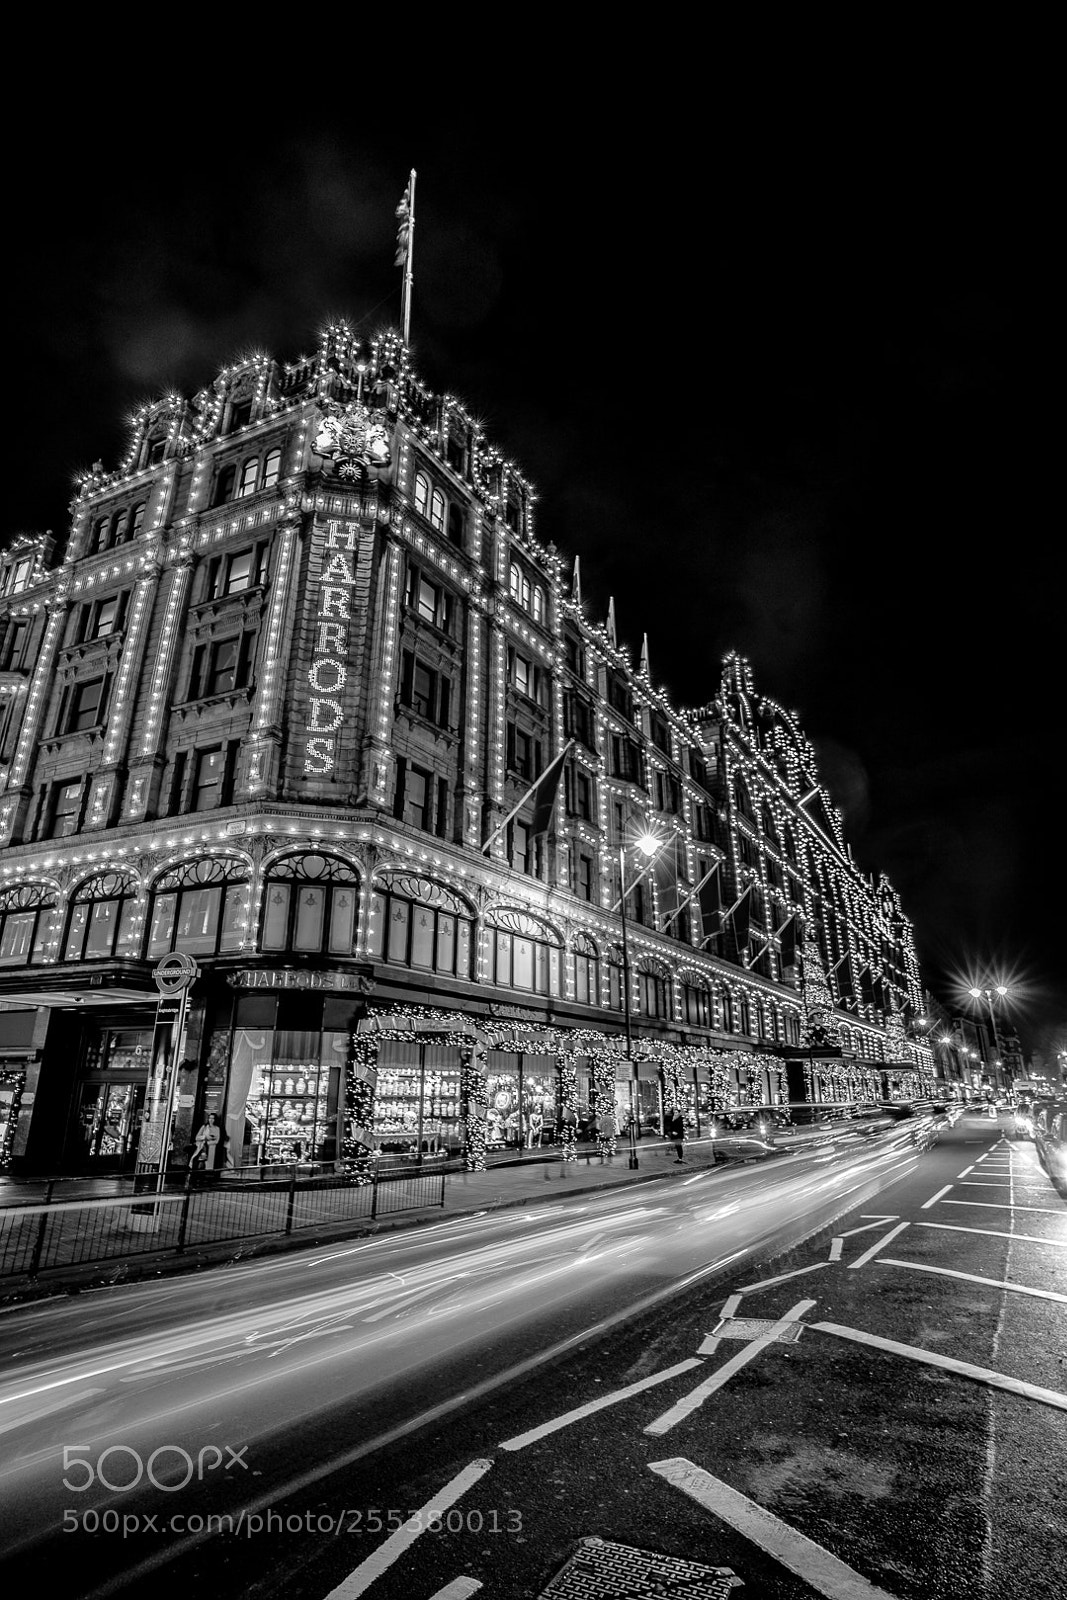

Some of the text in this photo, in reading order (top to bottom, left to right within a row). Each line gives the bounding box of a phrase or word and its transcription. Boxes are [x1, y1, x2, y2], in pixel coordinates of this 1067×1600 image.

[303, 518, 361, 773] HARRODS
[153, 968, 191, 976] UNDERGROUND
[245, 970, 334, 989] HARRODS
[135, 1044, 143, 1056] 6
